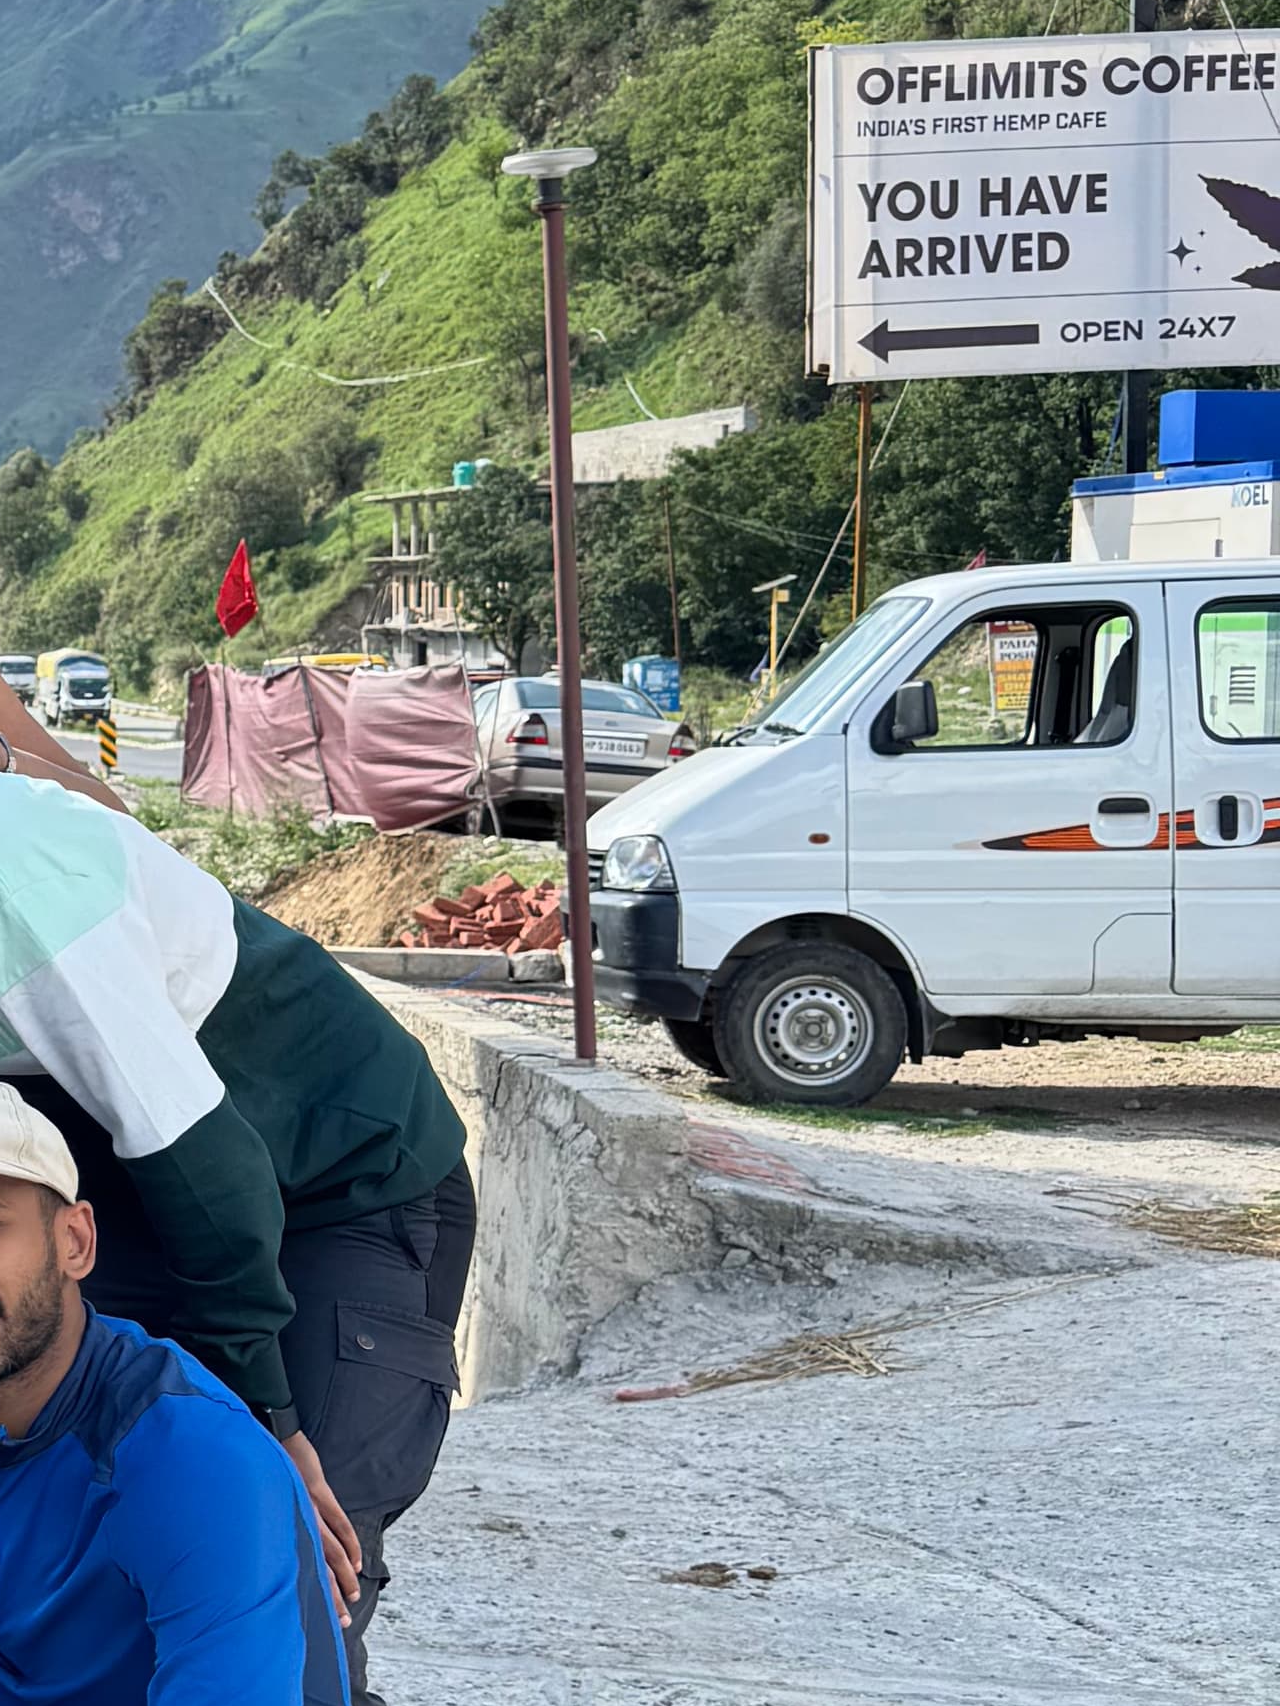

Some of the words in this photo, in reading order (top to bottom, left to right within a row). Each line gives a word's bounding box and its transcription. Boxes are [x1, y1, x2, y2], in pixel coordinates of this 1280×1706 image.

[857, 58, 1087, 105] OFFLIMITS
[1103, 53, 1276, 95] COFFEE
[857, 118, 926, 138] INDIA'S
[932, 115, 988, 135] FIRST
[993, 113, 1050, 132] HEMP
[1056, 111, 1107, 130] CAFE
[858, 179, 959, 223] YOU
[980, 172, 1108, 217] HAVE
[858, 231, 1071, 279] ARRIVED
[1060, 319, 1144, 344] OPEN
[1158, 315, 1237, 340] 24X7
